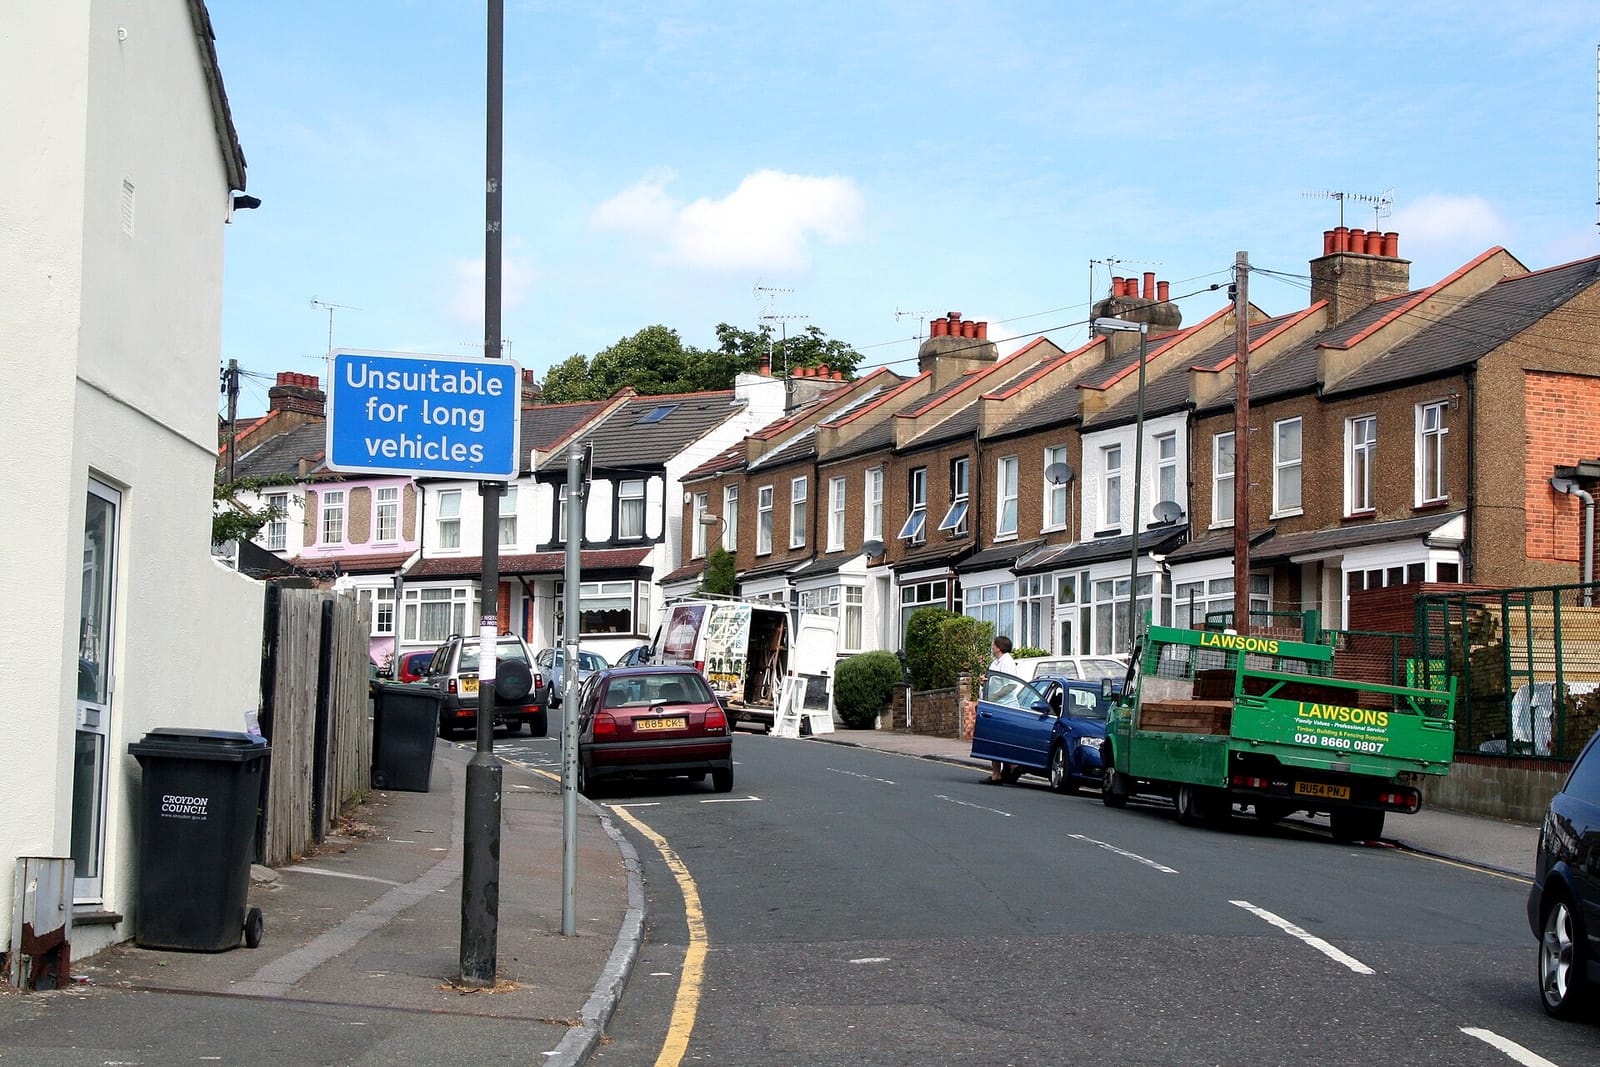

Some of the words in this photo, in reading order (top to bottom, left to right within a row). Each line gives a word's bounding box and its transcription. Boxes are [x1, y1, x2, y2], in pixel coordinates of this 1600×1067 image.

[347, 362, 503, 396] Unsuitable
[366, 396, 408, 422] for
[422, 399, 485, 433] long
[365, 433, 484, 463] vehicles
[1200, 633, 1279, 654] LAWSONS
[1298, 701, 1389, 727] LAWSONS
[1294, 733, 1318, 744] 020
[1321, 736, 1350, 748] 8660
[1353, 740, 1384, 752] 0807
[162, 794, 208, 806] CROYDON
[1299, 783, 1324, 794] BU54
[1326, 786, 1347, 797] PNJ
[161, 803, 208, 815] COUNCIL
